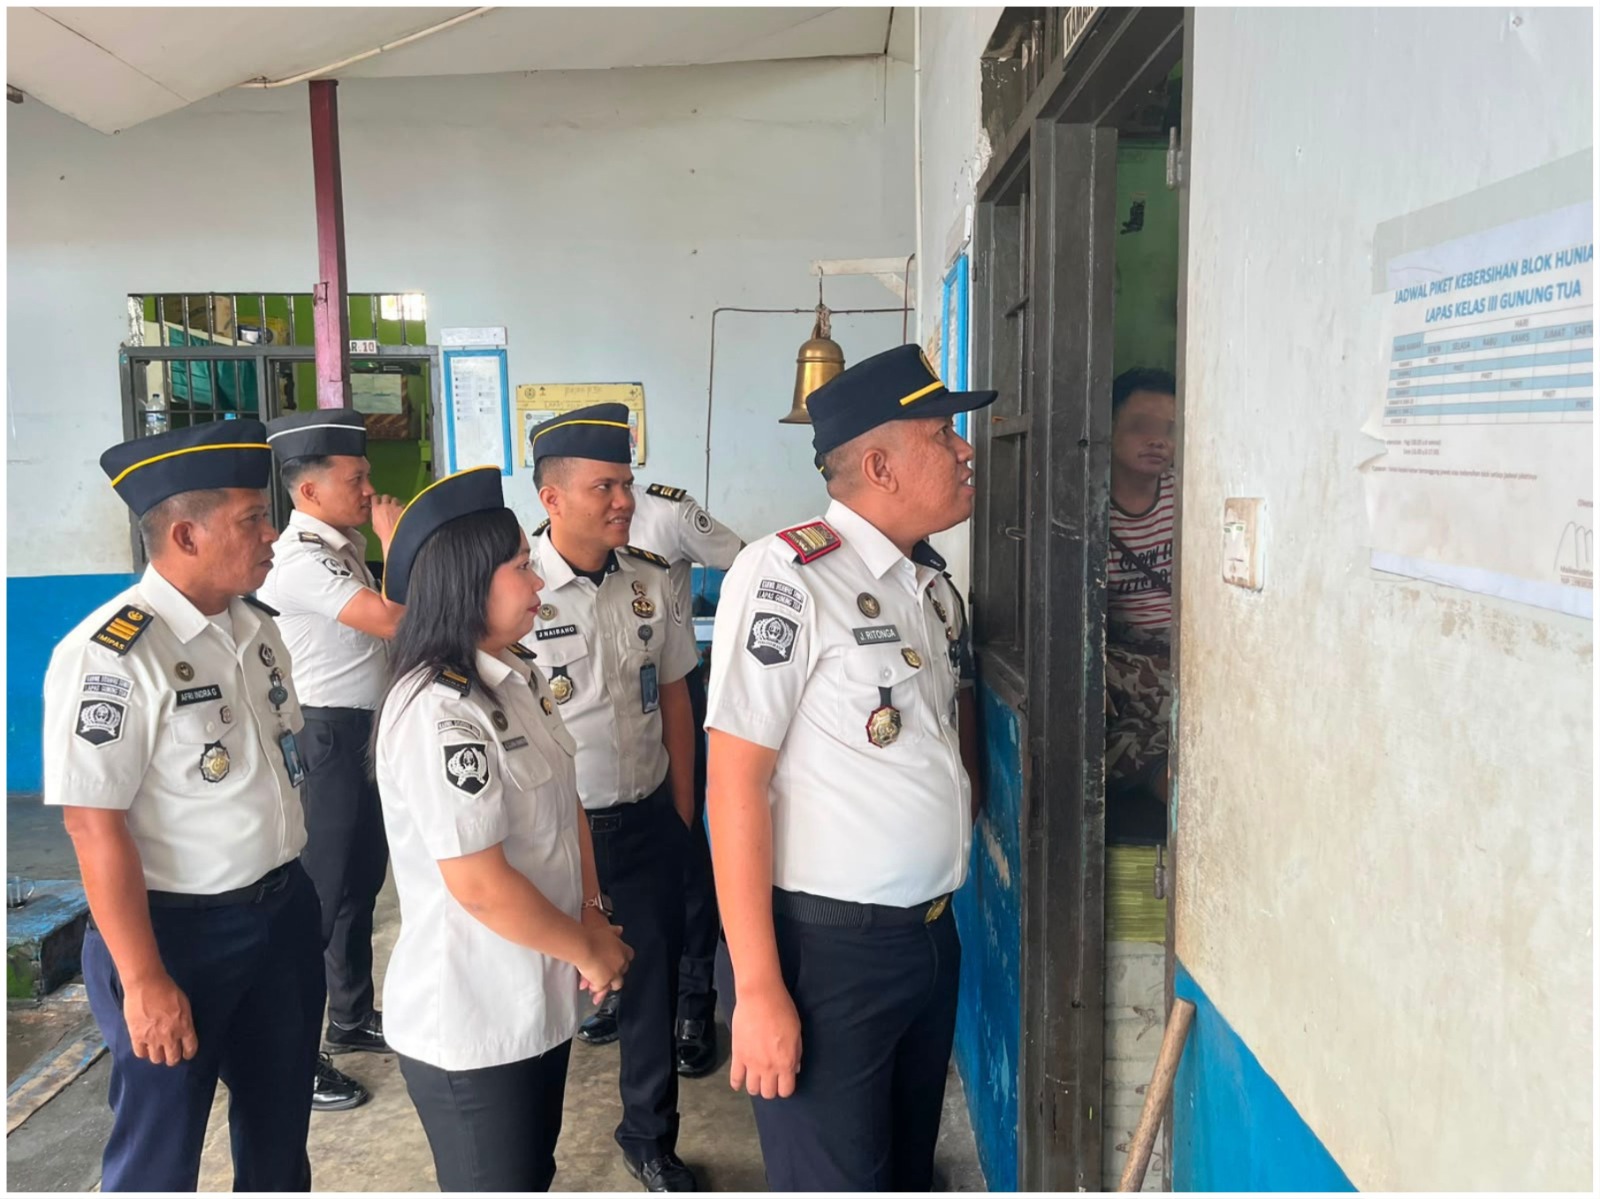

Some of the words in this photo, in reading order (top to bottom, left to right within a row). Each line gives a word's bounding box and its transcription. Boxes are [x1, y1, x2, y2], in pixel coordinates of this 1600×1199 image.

[1066, 7, 1094, 50] KAMA
[1394, 284, 1428, 304] JADWAL
[1429, 277, 1454, 295] PIKET
[1454, 262, 1519, 290] KEBERSIHAN
[1520, 253, 1553, 276] BLOK
[1425, 304, 1453, 323] LAPAS
[1454, 298, 1486, 318] KELAS
[1487, 295, 1498, 312] III
[1500, 285, 1553, 310] GUNUNG
[1556, 279, 1582, 299] TUA
[97, 633, 126, 651] IMIPAS
[866, 629, 897, 641] RITONGA
